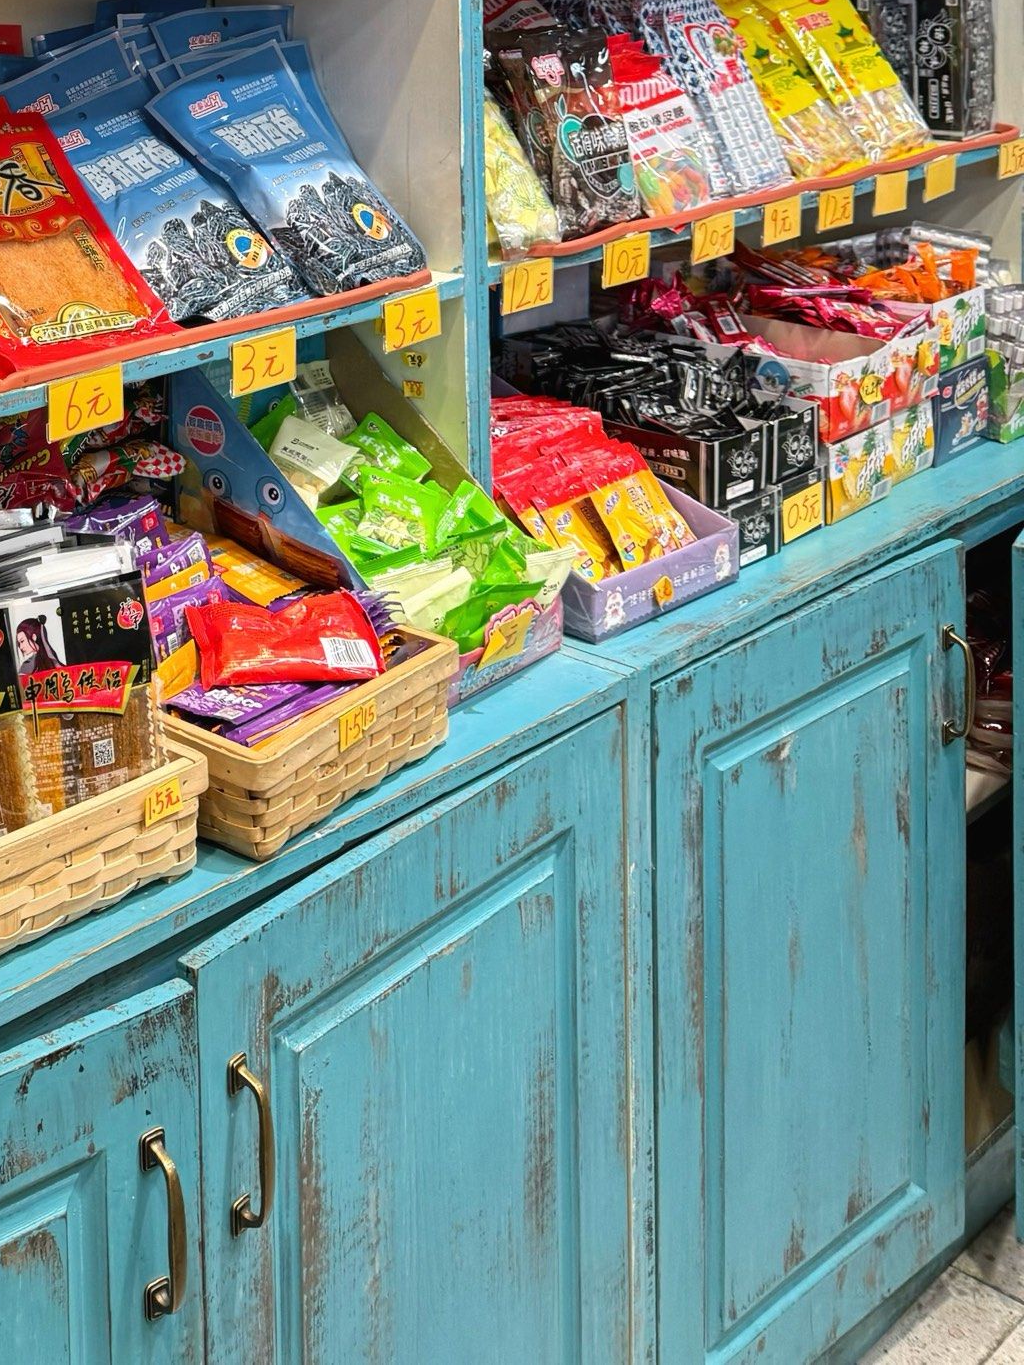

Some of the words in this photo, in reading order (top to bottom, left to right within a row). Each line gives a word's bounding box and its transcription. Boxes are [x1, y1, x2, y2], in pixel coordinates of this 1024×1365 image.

[76, 137, 183, 202] 酸甜西梅
[607, 239, 647, 280] 10元
[509, 263, 549, 310] 12元
[393, 302, 433, 350] 3元
[239, 344, 285, 392] 3元
[63, 387, 114, 432] 6元
[787, 494, 821, 530] 0.5元
[146, 790, 181, 821] 1.5元
